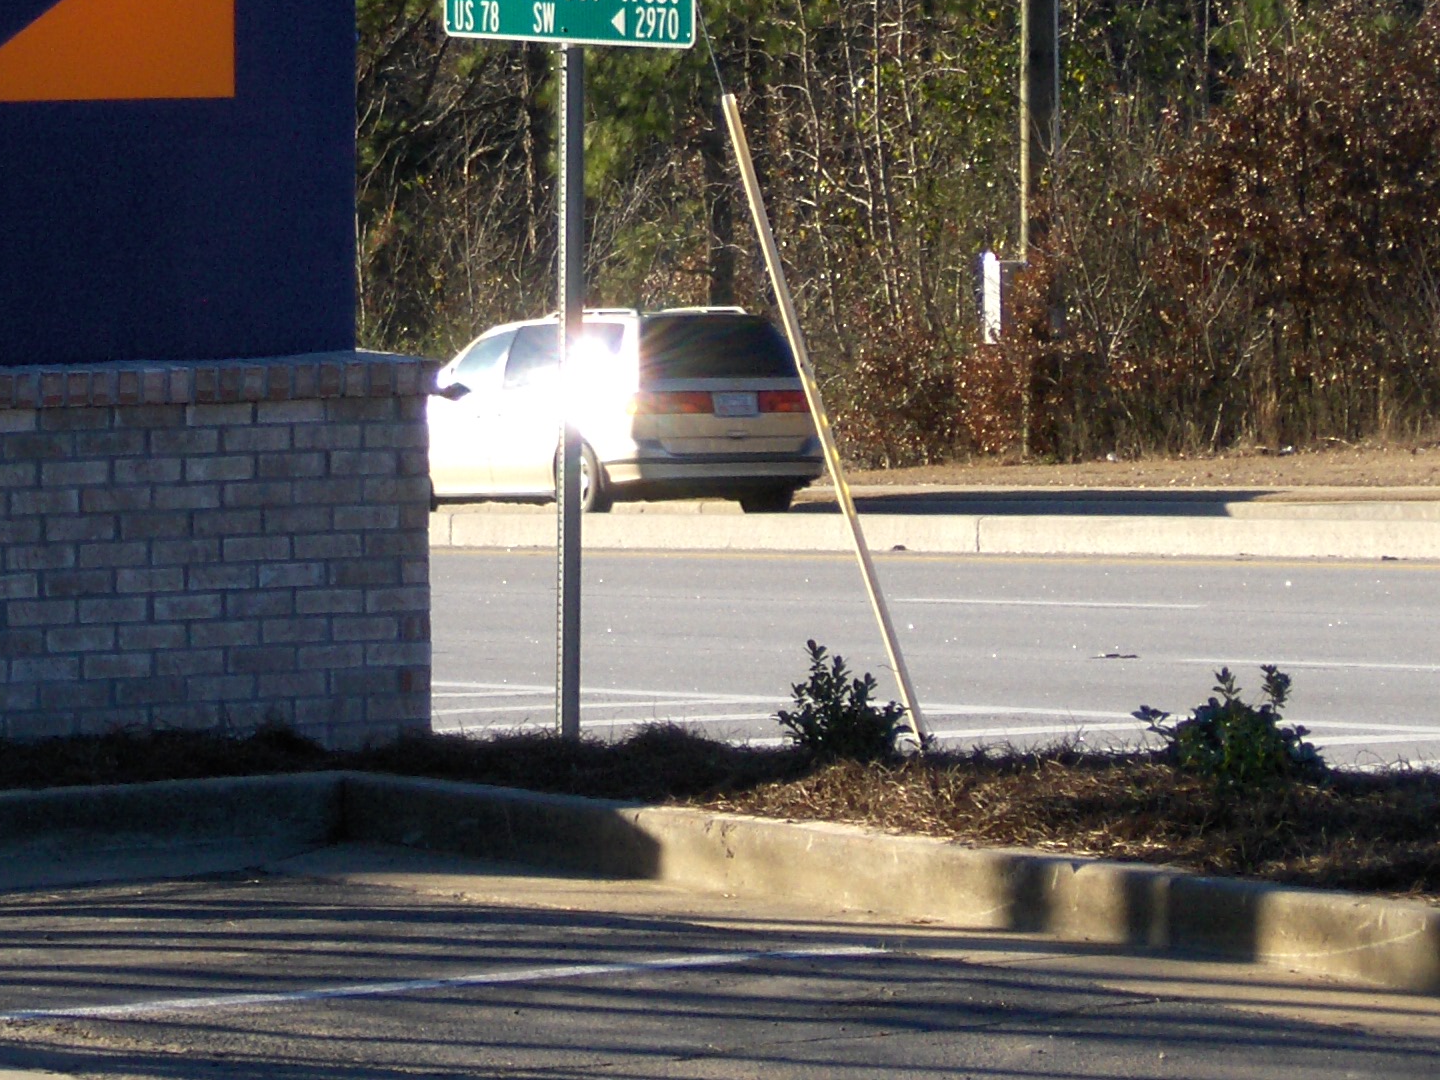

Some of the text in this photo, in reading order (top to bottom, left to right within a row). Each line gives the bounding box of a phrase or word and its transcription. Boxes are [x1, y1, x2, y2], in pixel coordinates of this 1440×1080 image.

[454, 0, 680, 41] US 78 SW 2970
